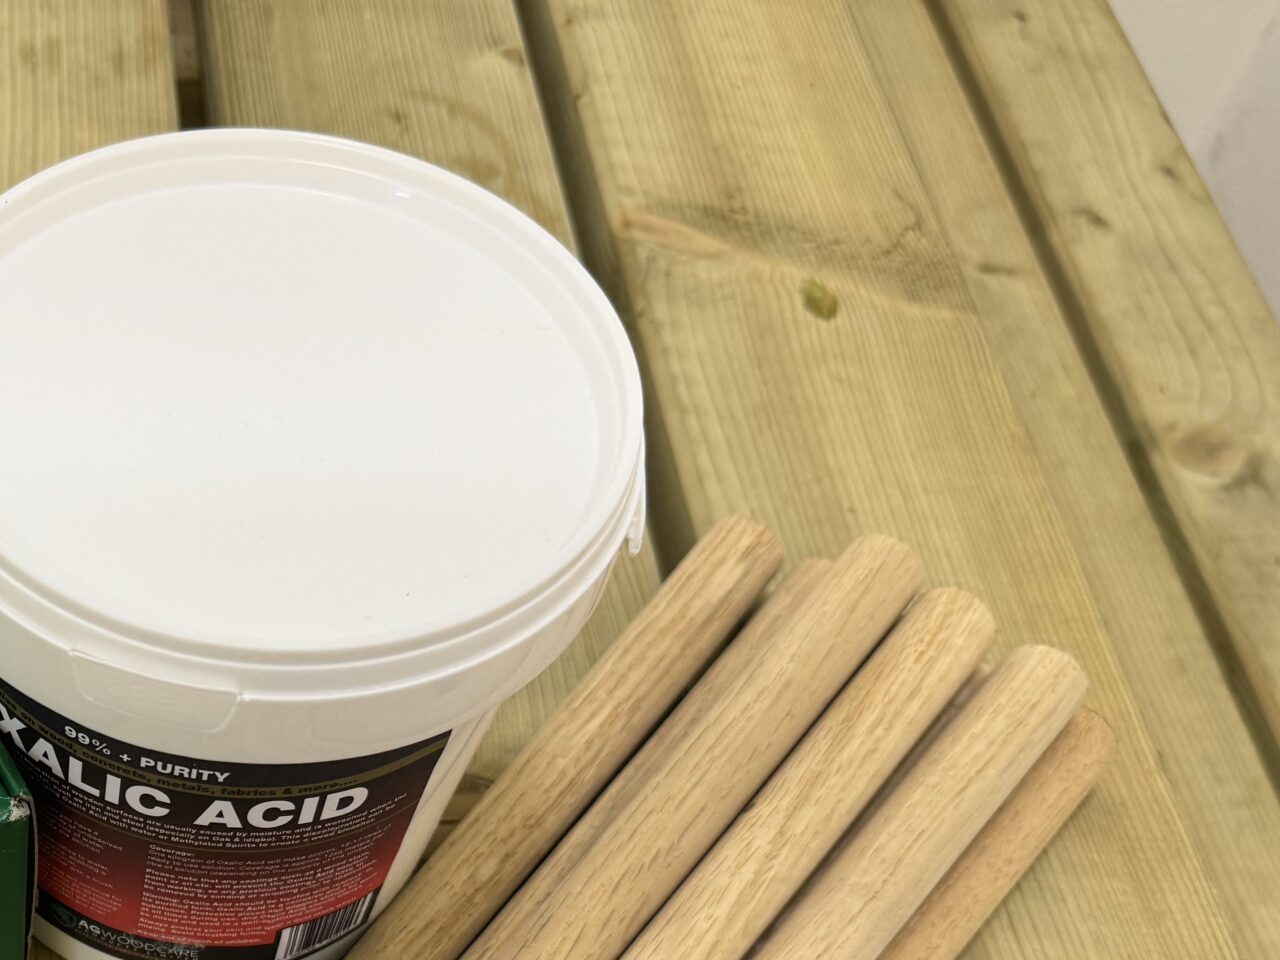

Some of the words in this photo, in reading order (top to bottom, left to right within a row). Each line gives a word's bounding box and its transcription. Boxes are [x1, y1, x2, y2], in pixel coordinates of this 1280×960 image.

[64, 725, 111, 756] 99%
[140, 756, 232, 783] PURITY
[82, 750, 150, 782] concrete,
[156, 777, 214, 793] metals,
[220, 787, 276, 795] fabrics
[70, 787, 104, 808] wooden
[104, 803, 144, 823] surfaces
[146, 818, 162, 827] are
[162, 822, 197, 834] usually
[198, 828, 234, 836] caused
[249, 828, 292, 837] moisture
[294, 825, 312, 833] and
[102, 809, 120, 820] and
[121, 816, 144, 828] steel
[280, 832, 300, 840] This
[192, 787, 369, 829] ACID
[88, 808, 107, 822] Acid
[108, 817, 128, 830] with
[130, 825, 156, 838] water
[170, 835, 223, 848] Methylated
[270, 837, 300, 846] create
[148, 843, 194, 858] Coverage:
[144, 867, 176, 879] Please
[176, 874, 198, 882] note
[144, 872, 168, 884] paint
[156, 886, 196, 898] removed
